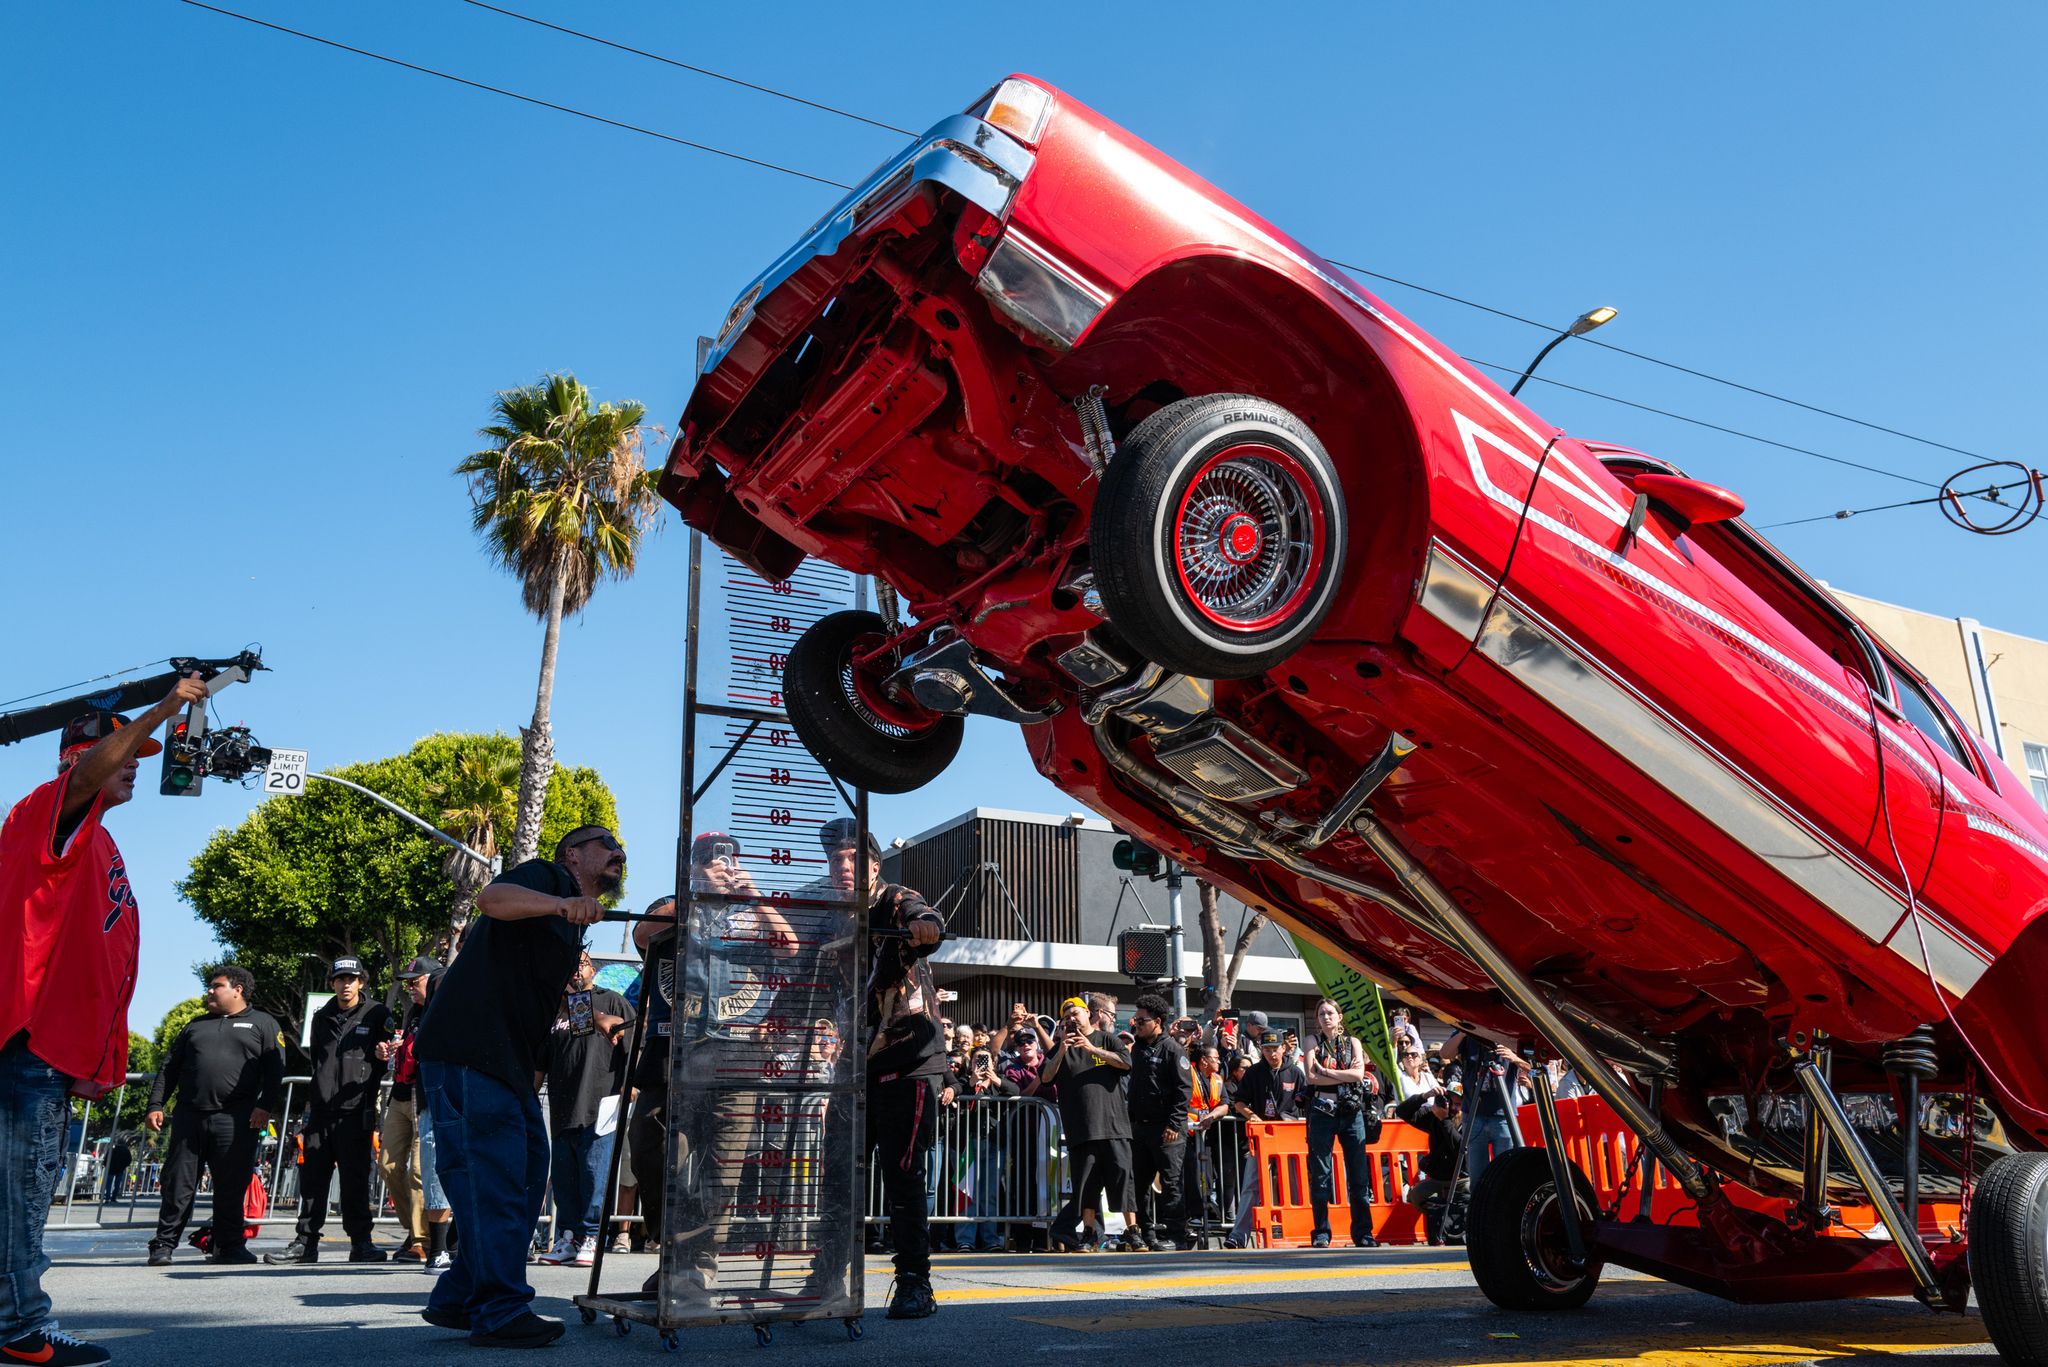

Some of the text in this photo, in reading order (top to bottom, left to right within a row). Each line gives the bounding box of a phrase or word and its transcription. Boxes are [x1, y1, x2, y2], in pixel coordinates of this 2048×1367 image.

[271, 753, 305, 763] SPEED
[273, 762, 300, 771] LIMIT
[269, 772, 301, 790] 20
[1326, 977, 1371, 1044] AVENUE
